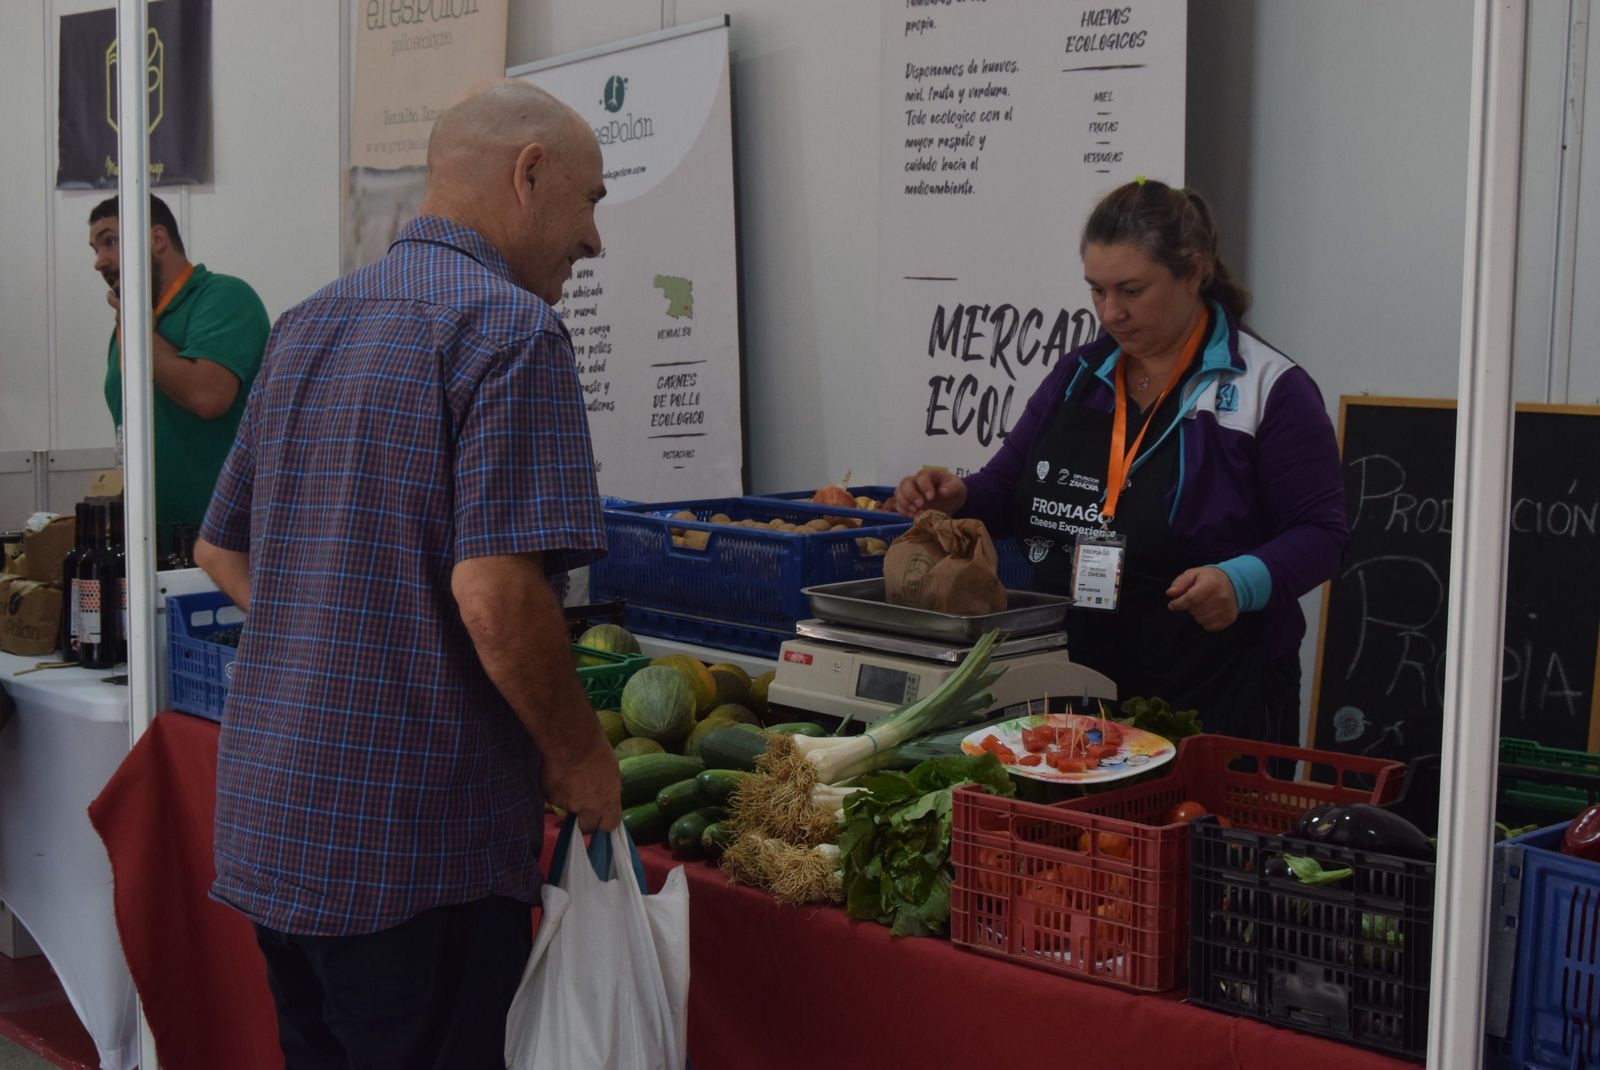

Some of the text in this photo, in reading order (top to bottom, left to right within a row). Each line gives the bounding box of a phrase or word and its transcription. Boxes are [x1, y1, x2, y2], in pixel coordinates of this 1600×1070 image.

[1080, 7, 1132, 28] HUEVOS
[905, 62, 964, 82] Disponemos
[967, 58, 978, 74] de
[928, 83, 955, 101] fruta
[958, 87, 966, 104] y
[1093, 90, 1115, 103] MIEL
[905, 108, 927, 126] Todo
[980, 110, 1001, 122] con
[1004, 105, 1014, 122] el
[1088, 121, 1120, 134] FRUTAS
[904, 130, 987, 153] mayor respeto y
[904, 155, 979, 173] cuidado hacia el
[1083, 151, 1124, 166] VERDURAS
[572, 282, 603, 299] ubicada
[573, 303, 598, 319] rural
[588, 324, 611, 339] carga
[588, 340, 613, 360] pollos
[588, 358, 606, 374] edad
[603, 381, 611, 396] y
[656, 372, 698, 390] CARNES
[653, 391, 701, 409] DE POLLO
[1030, 515, 1057, 530] Cheese
